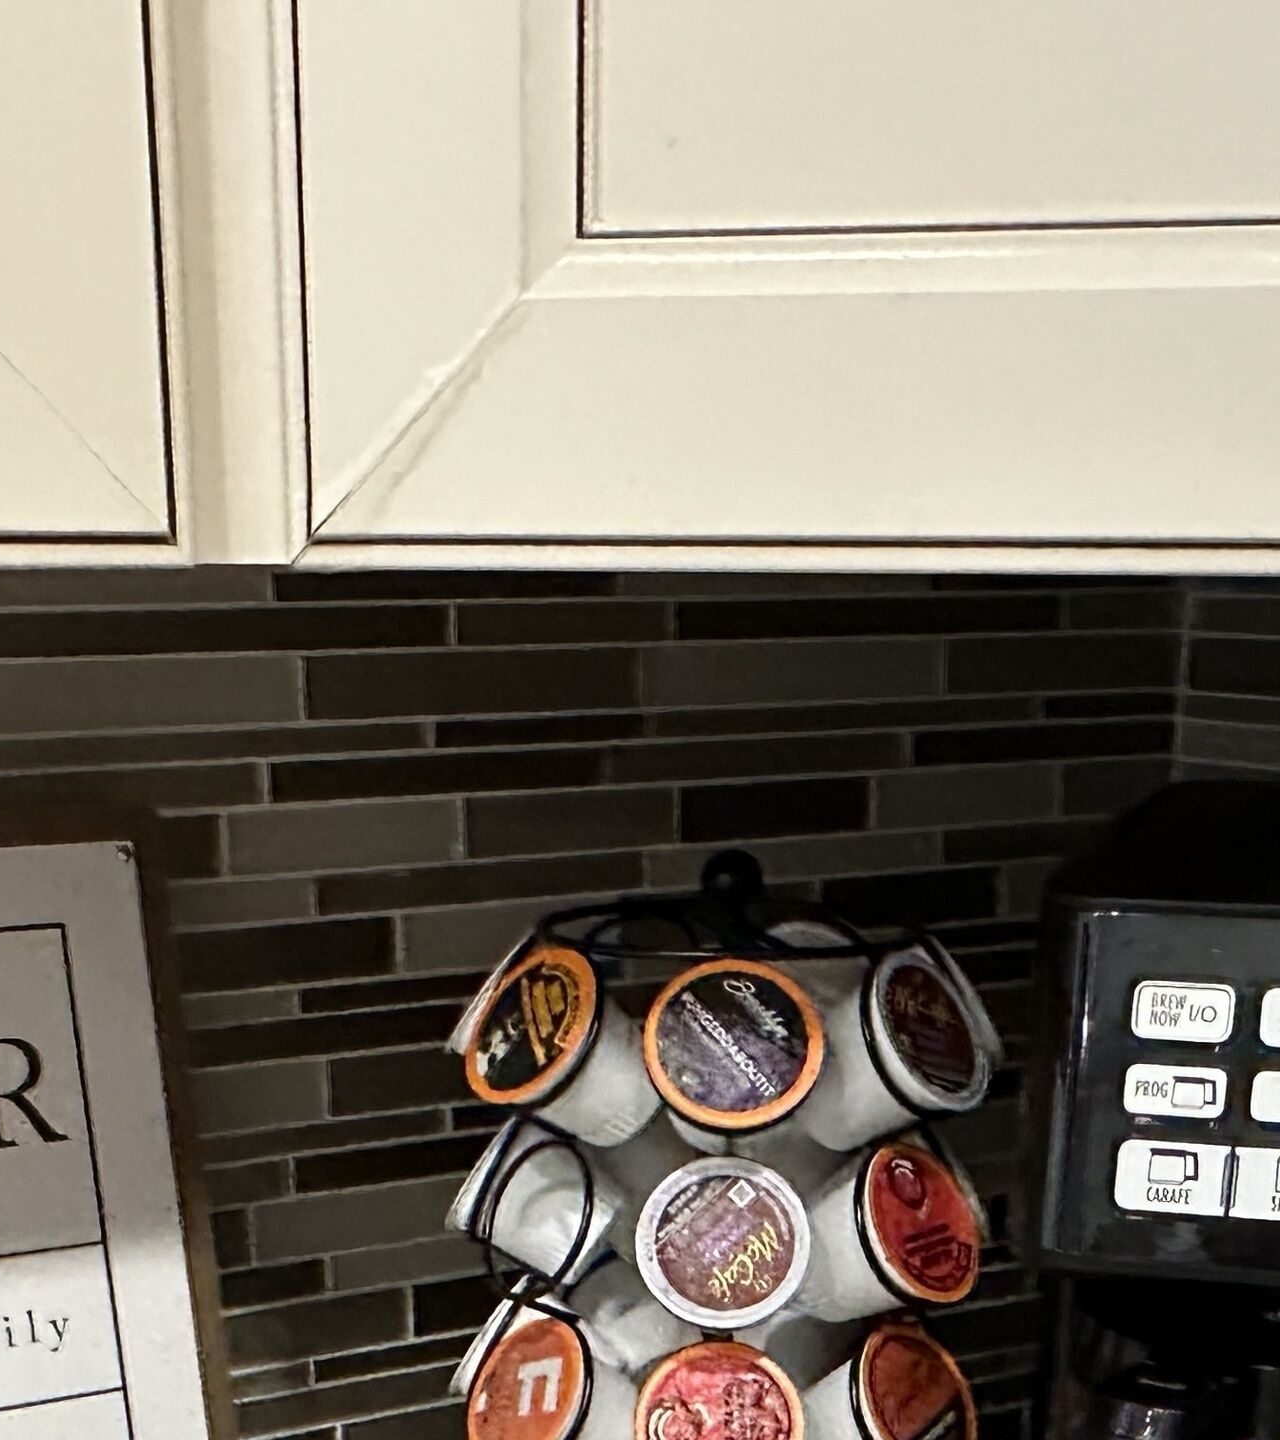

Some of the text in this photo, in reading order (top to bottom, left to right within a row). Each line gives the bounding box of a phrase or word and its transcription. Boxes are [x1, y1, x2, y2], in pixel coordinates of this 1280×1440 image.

[1150, 991, 1187, 1011] BREW
[1149, 1010, 1181, 1028] NOW
[1134, 1079, 1169, 1099] PROG
[1145, 1186, 1193, 1206] CARAFE
